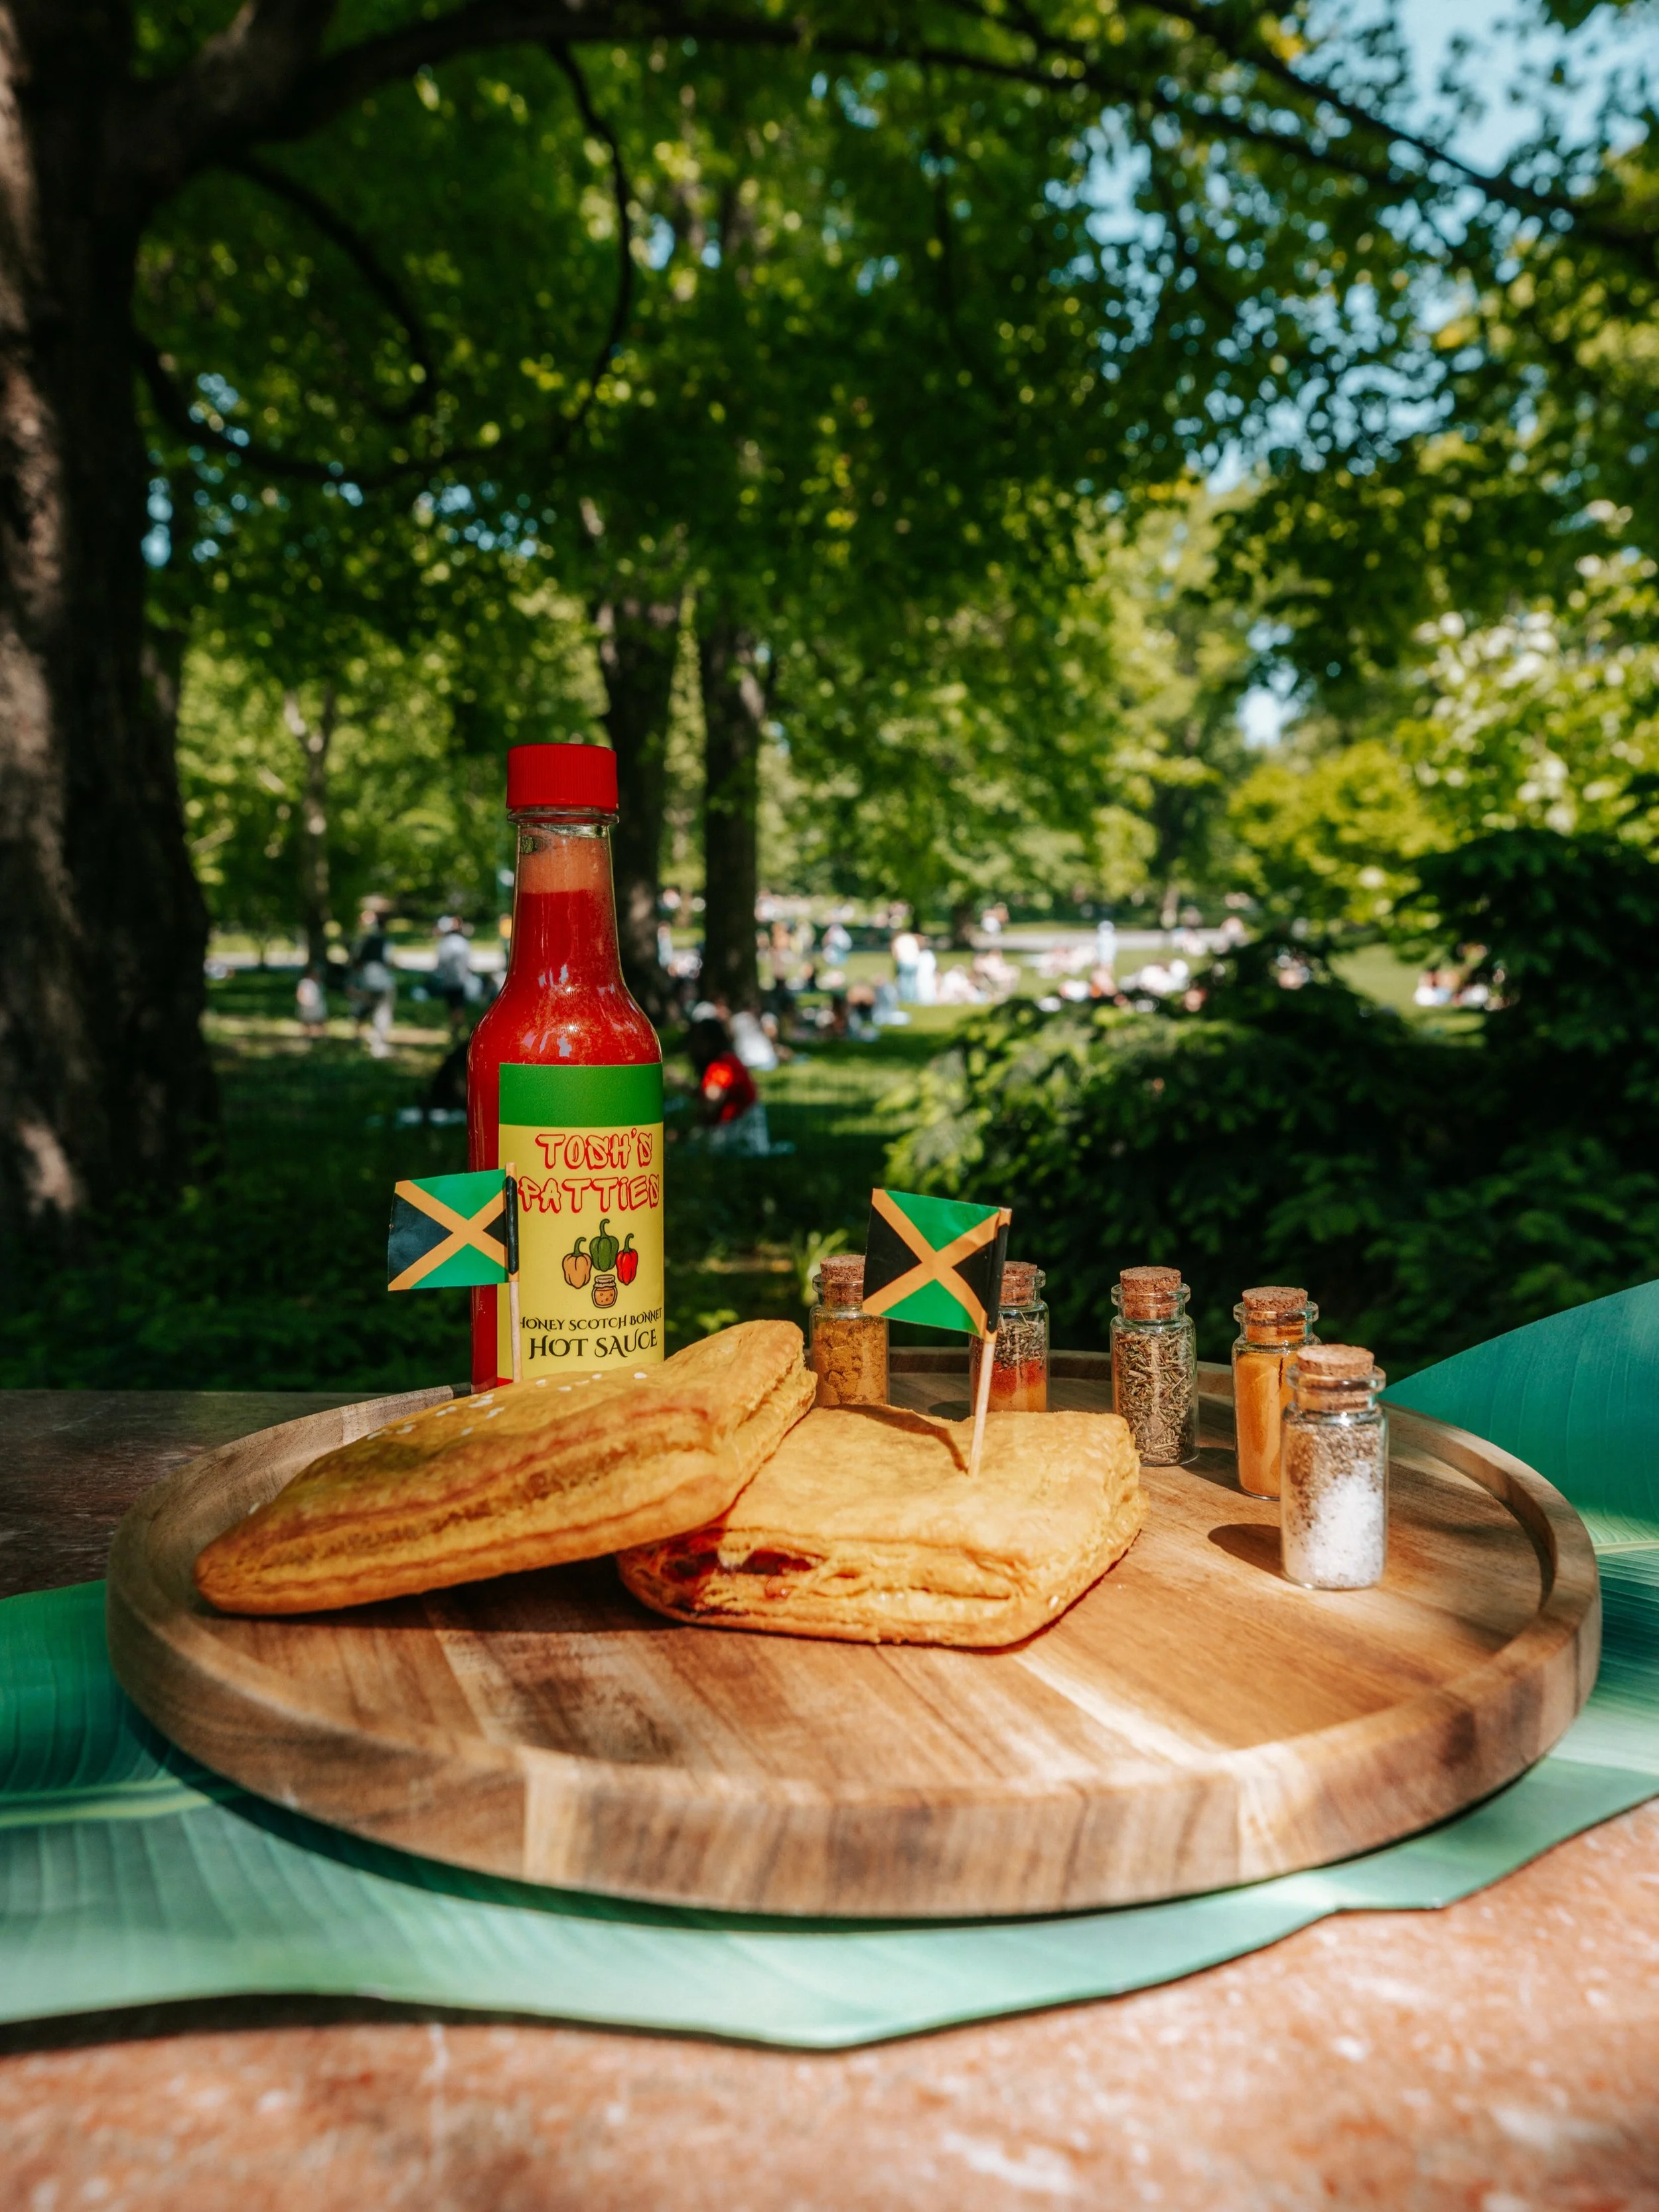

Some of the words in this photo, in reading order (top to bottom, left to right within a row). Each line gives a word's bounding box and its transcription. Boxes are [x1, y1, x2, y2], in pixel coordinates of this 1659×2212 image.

[535, 1128, 653, 1170] TOSH'S
[568, 1314, 627, 1331] SCOTCH
[629, 1307, 662, 1326] BONNET
[528, 1335, 589, 1360] HOT
[594, 1328, 658, 1358] SAUCE
